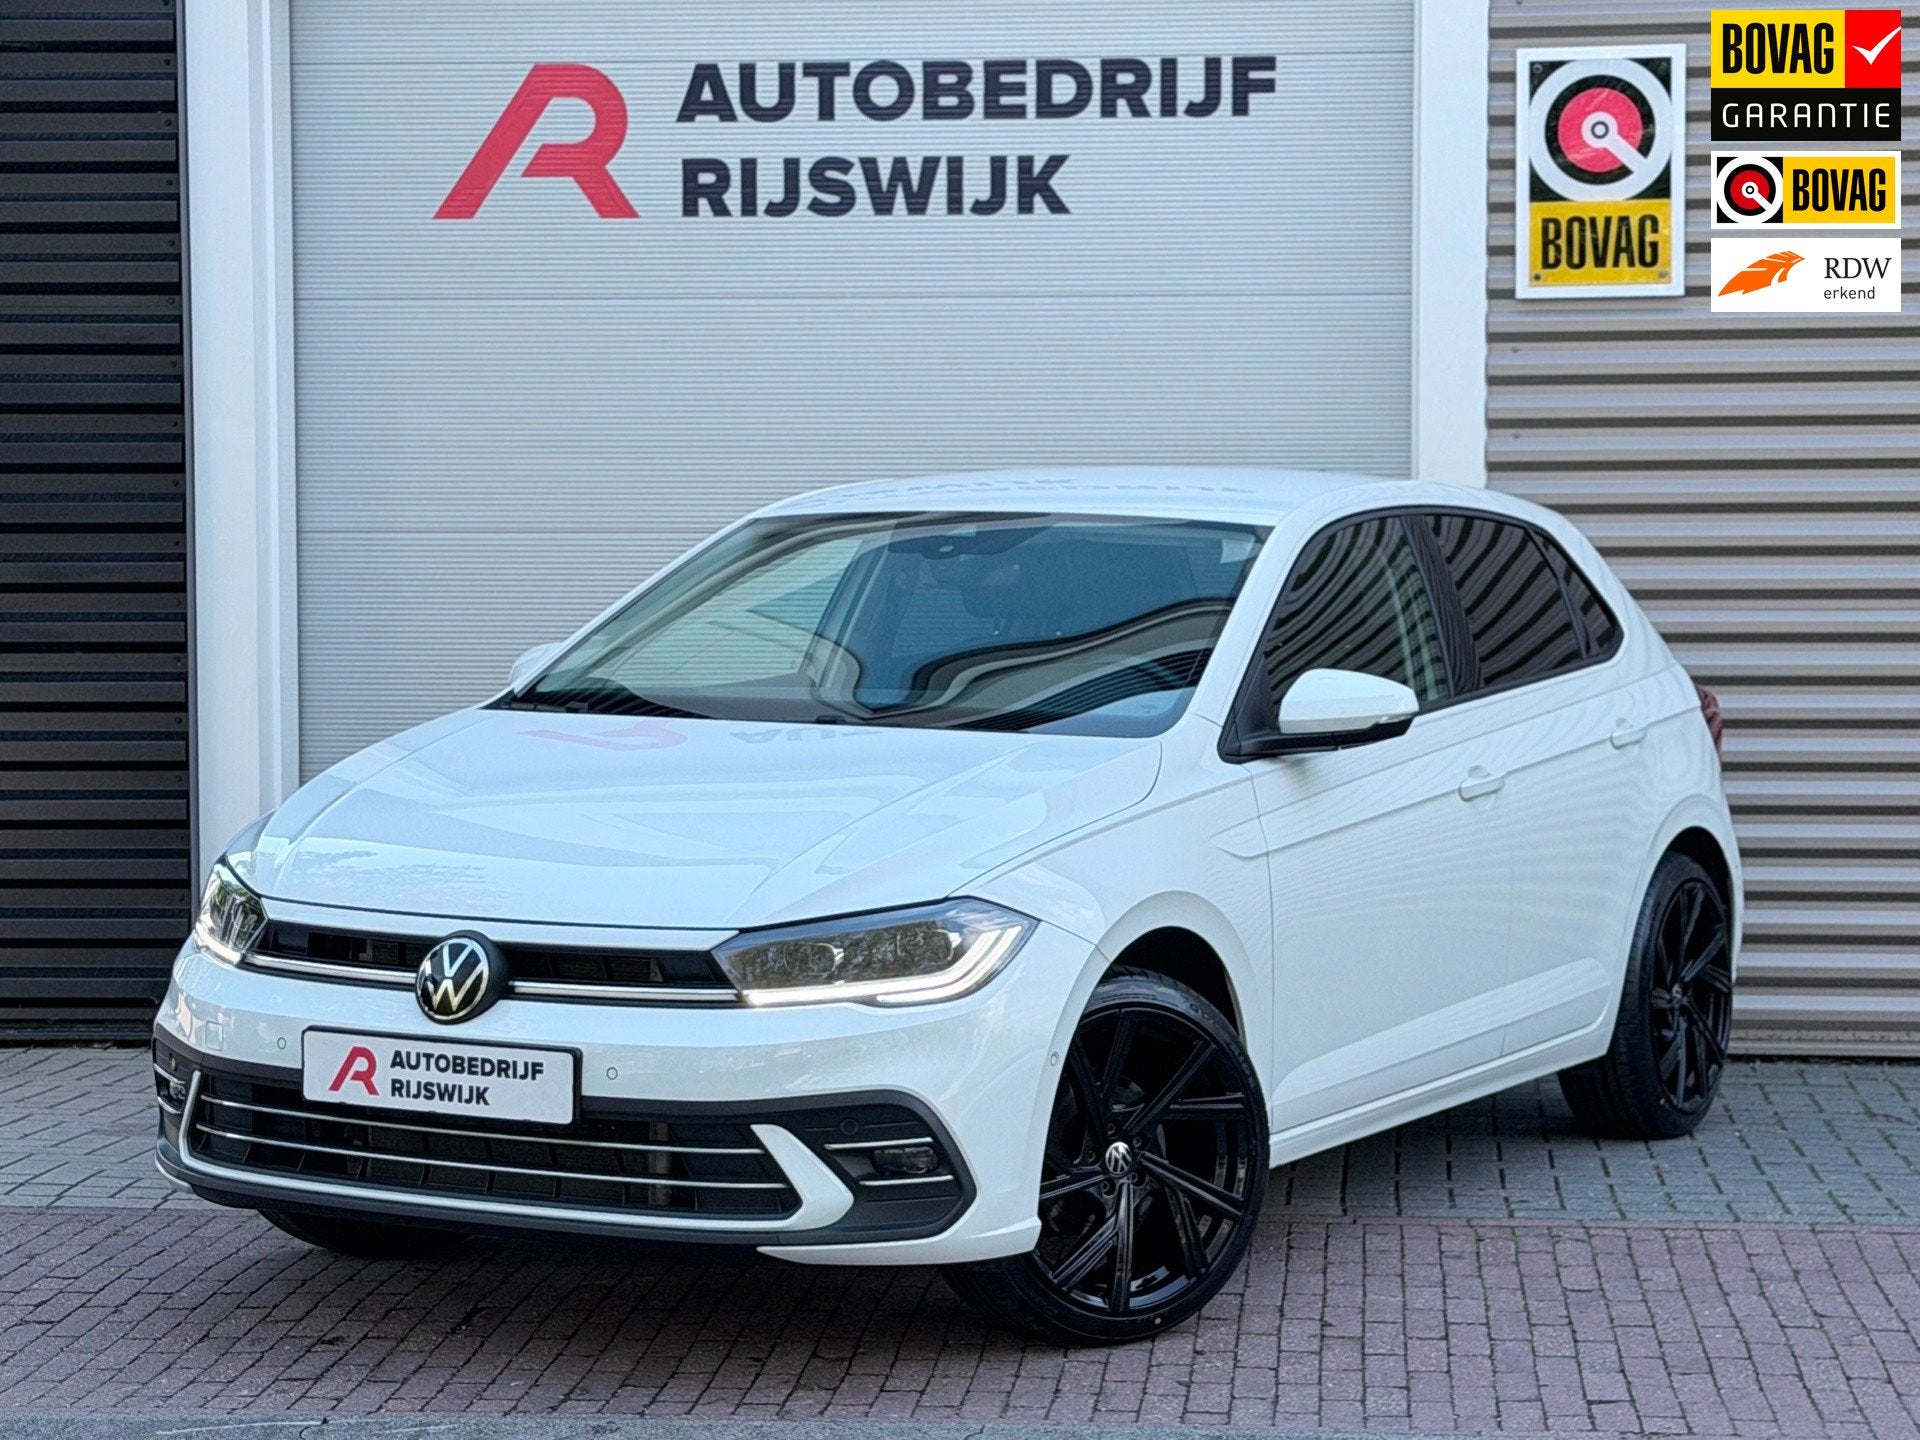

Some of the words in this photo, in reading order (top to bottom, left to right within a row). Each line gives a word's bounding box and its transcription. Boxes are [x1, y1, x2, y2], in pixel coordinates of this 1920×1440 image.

[676, 55, 1277, 122] AUTOBEDRIJF
[682, 154, 1071, 217] RIJSWIJK
[1541, 214, 1659, 270] BOVAG
[390, 1050, 545, 1080] AUTOBEDRIJF
[390, 1079, 490, 1106] RIJSWIJK
